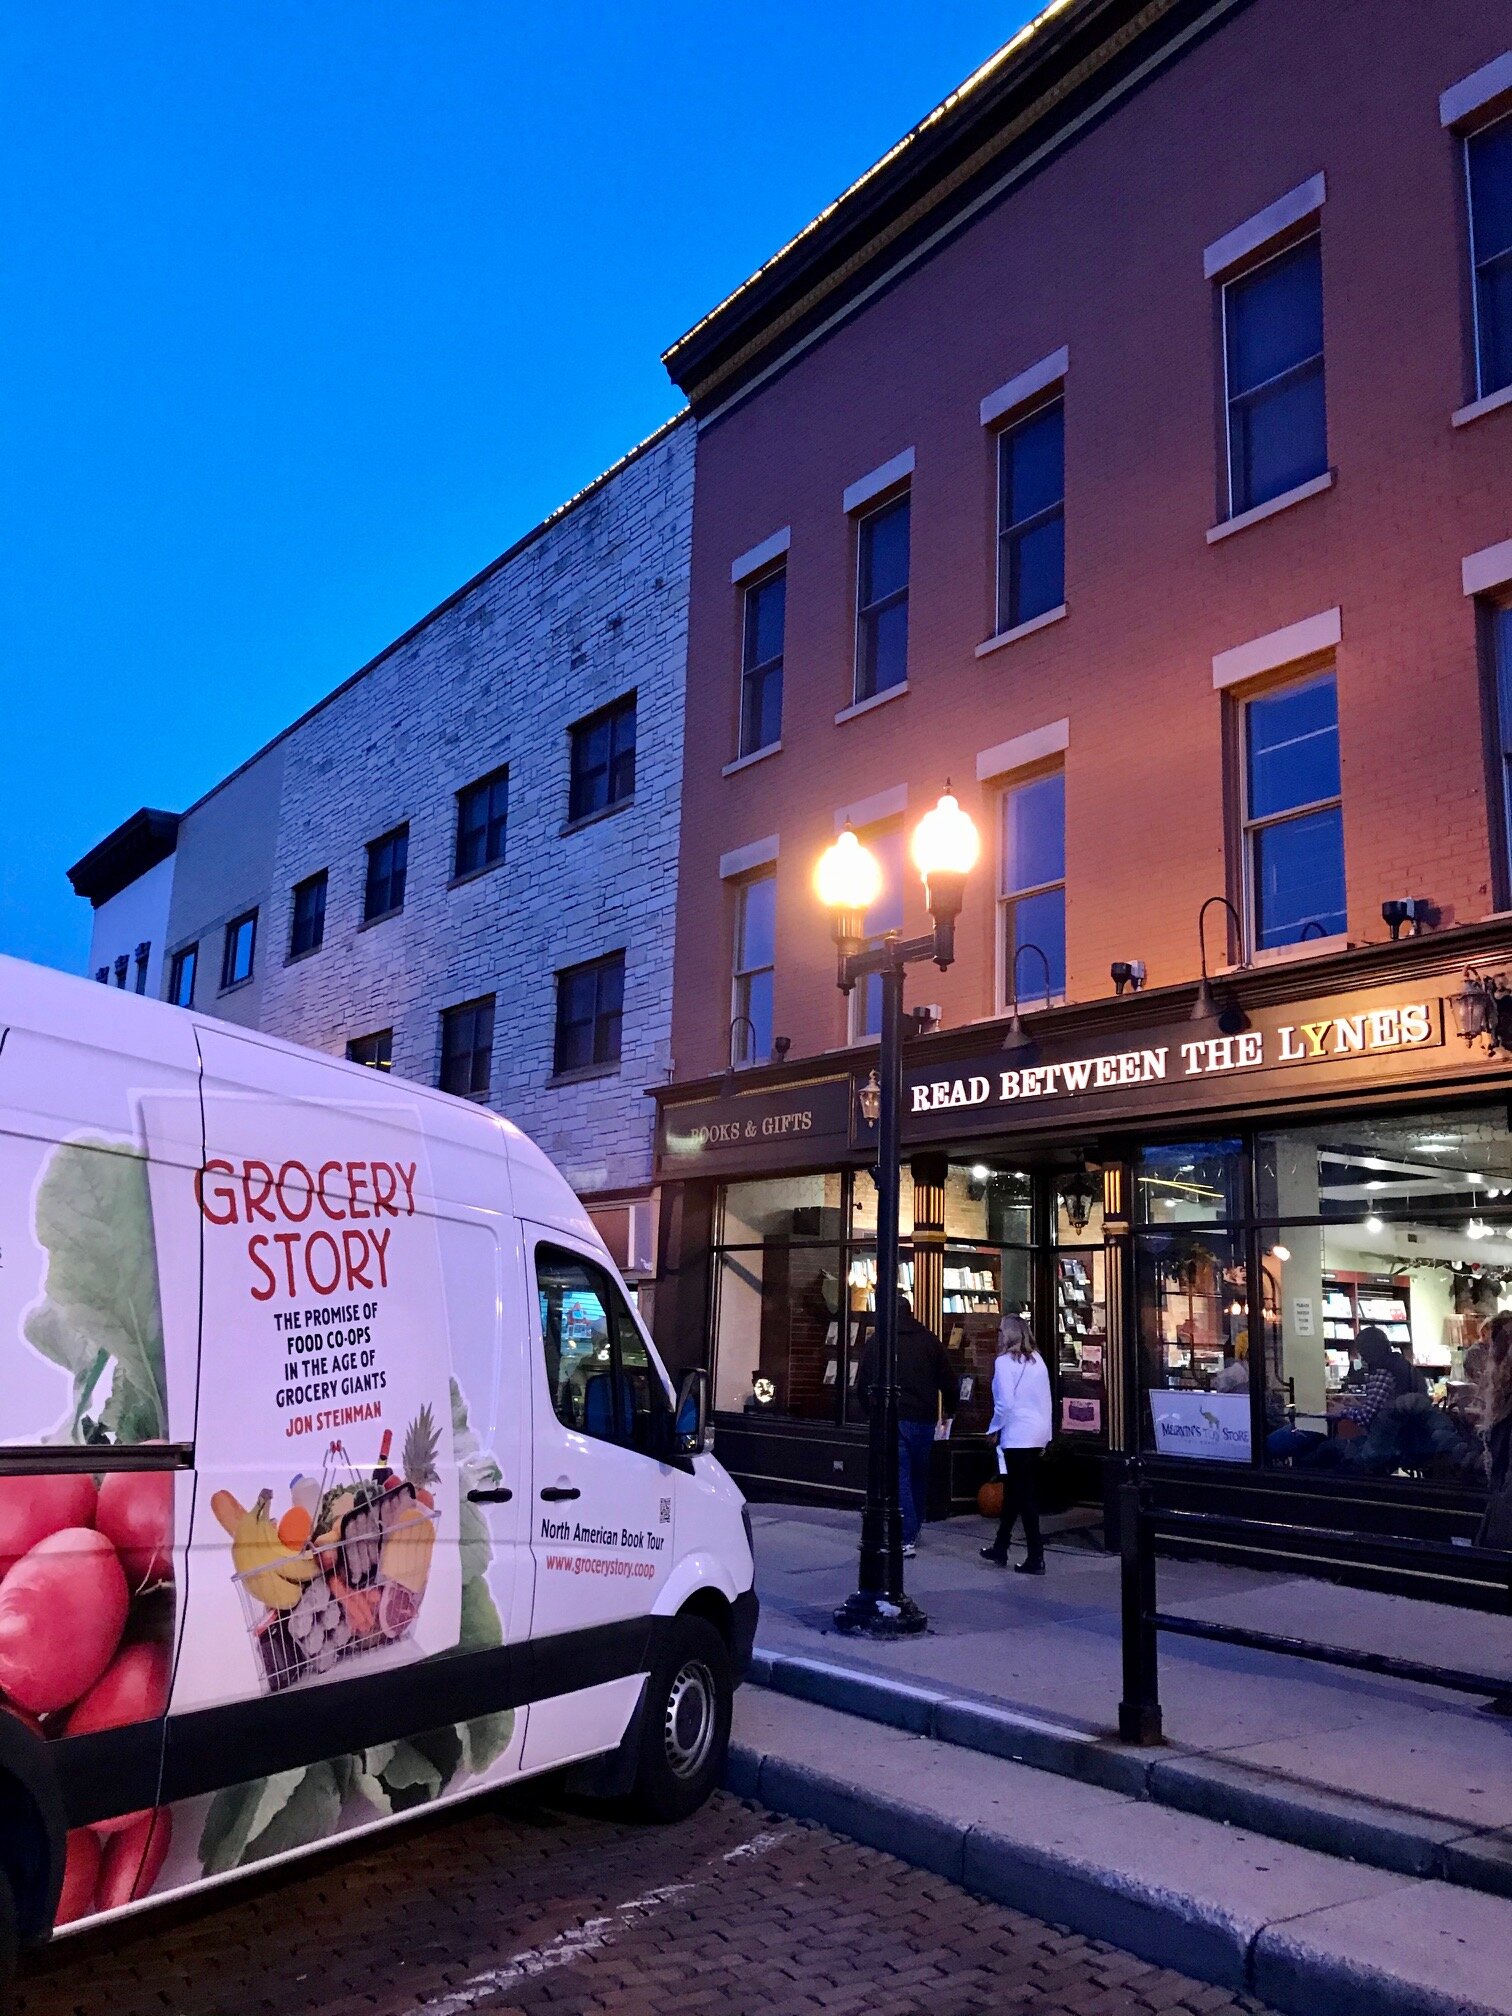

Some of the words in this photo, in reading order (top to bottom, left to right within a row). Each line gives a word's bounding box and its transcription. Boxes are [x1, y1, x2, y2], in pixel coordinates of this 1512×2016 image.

[911, 1075, 990, 1112] READ
[999, 1047, 1168, 1101] BETWEEN
[1181, 1032, 1264, 1075] THE
[1277, 1003, 1430, 1062] LYNES
[745, 1120, 757, 1138] &
[762, 1111, 812, 1135] GIFTS
[194, 1159, 416, 1225] GROCERY
[248, 1228, 390, 1301] STORY
[274, 1311, 301, 1331] THE
[305, 1305, 360, 1327] PROMISE
[363, 1302, 378, 1320] OF
[287, 1334, 323, 1355] FOOD
[285, 1361, 298, 1381] IN
[302, 1357, 328, 1378] THE
[332, 1353, 358, 1373] AGE
[360, 1349, 376, 1368] OF
[276, 1381, 337, 1408] GROCERY
[341, 1371, 387, 1396] GIANTS
[286, 1415, 313, 1438] JON
[316, 1401, 381, 1431] STEINMAN
[541, 1518, 570, 1540] North
[573, 1523, 618, 1546] American
[622, 1528, 644, 1548] Book
[647, 1532, 664, 1550] Tour
[546, 1554, 655, 1580] www.grocerystory.coop
